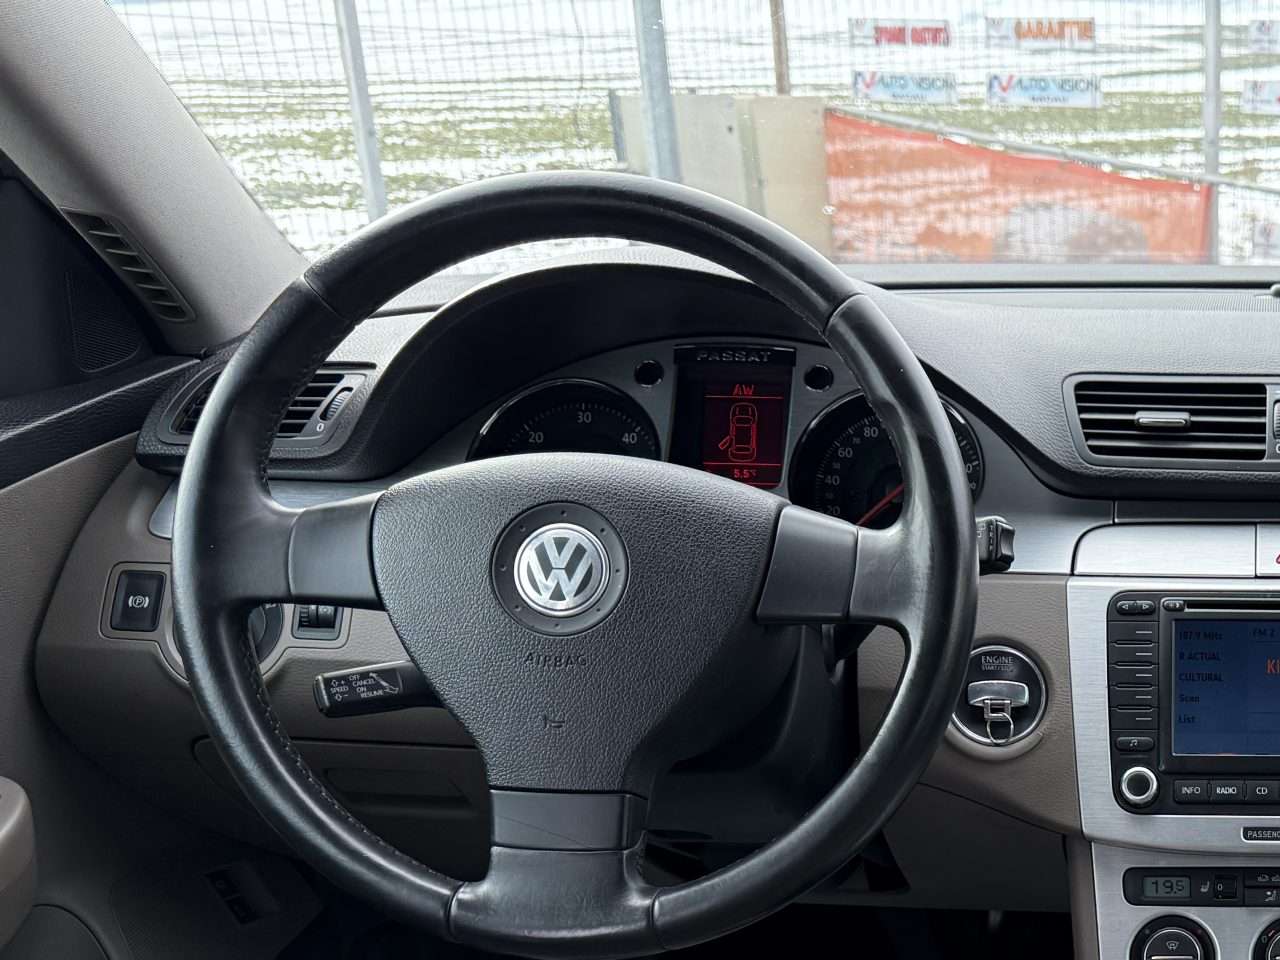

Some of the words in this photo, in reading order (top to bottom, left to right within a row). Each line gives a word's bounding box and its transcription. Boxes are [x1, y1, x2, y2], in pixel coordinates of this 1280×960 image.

[696, 350, 772, 361] PASSAT
[733, 383, 755, 396] AW
[577, 411, 592, 423] 30
[528, 431, 544, 443] 20
[863, 426, 879, 438] 80
[622, 432, 637, 444] 40
[837, 447, 853, 458] 60
[824, 475, 840, 486] 40
[825, 505, 841, 516] 20
[524, 652, 587, 669] AIRBAG
[981, 655, 1014, 665] ENGINE
[1187, 651, 1221, 661] ACTUAL
[1179, 672, 1224, 682] CULTURAL
[1178, 694, 1200, 704] Scan
[1178, 714, 1196, 724] List
[1181, 786, 1201, 795] INFO
[1216, 786, 1237, 795] RADIO
[1255, 786, 1268, 795] CD
[1151, 879, 1185, 895] 19.5
